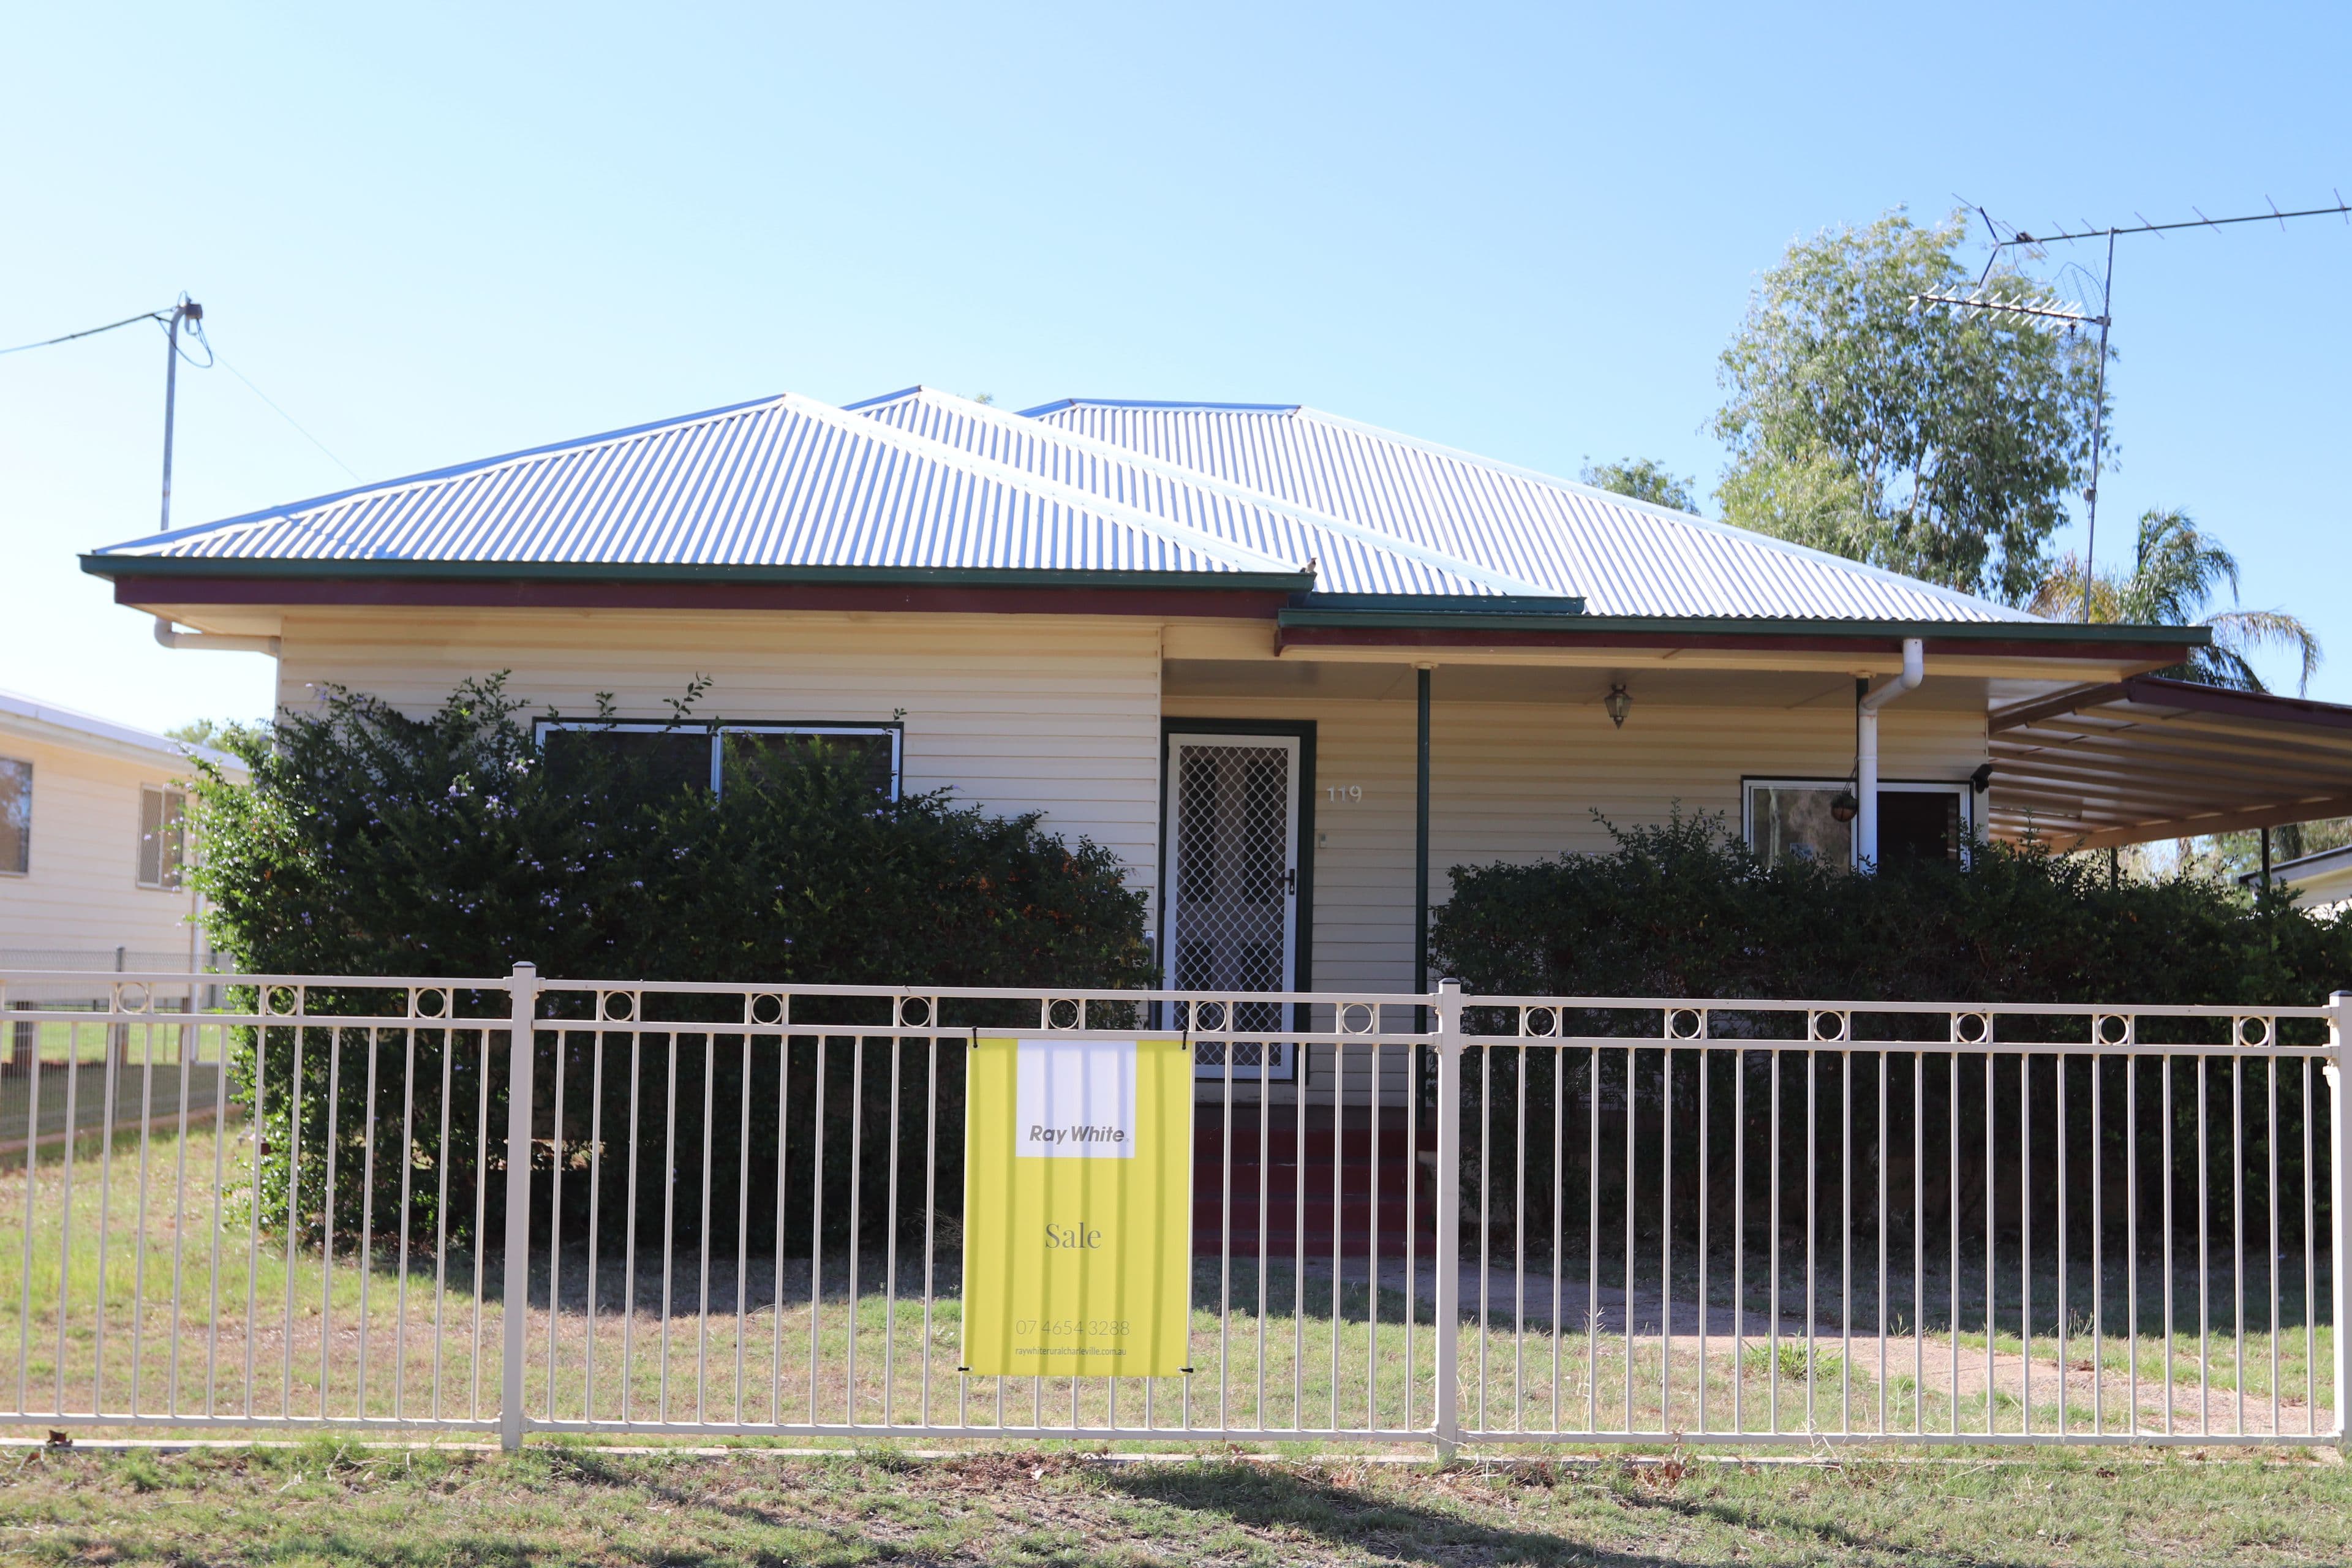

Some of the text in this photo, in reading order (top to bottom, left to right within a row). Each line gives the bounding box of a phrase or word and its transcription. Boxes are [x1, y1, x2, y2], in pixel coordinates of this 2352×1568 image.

[1327, 785, 1362, 804] 119
[1029, 1125, 1125, 1145] Ray White
[1045, 1221, 1101, 1249] Sale
[1016, 1320, 1130, 1336] 07 4654 3288
[1015, 1346, 1126, 1356] raywhiteruralcharleville.com.au
